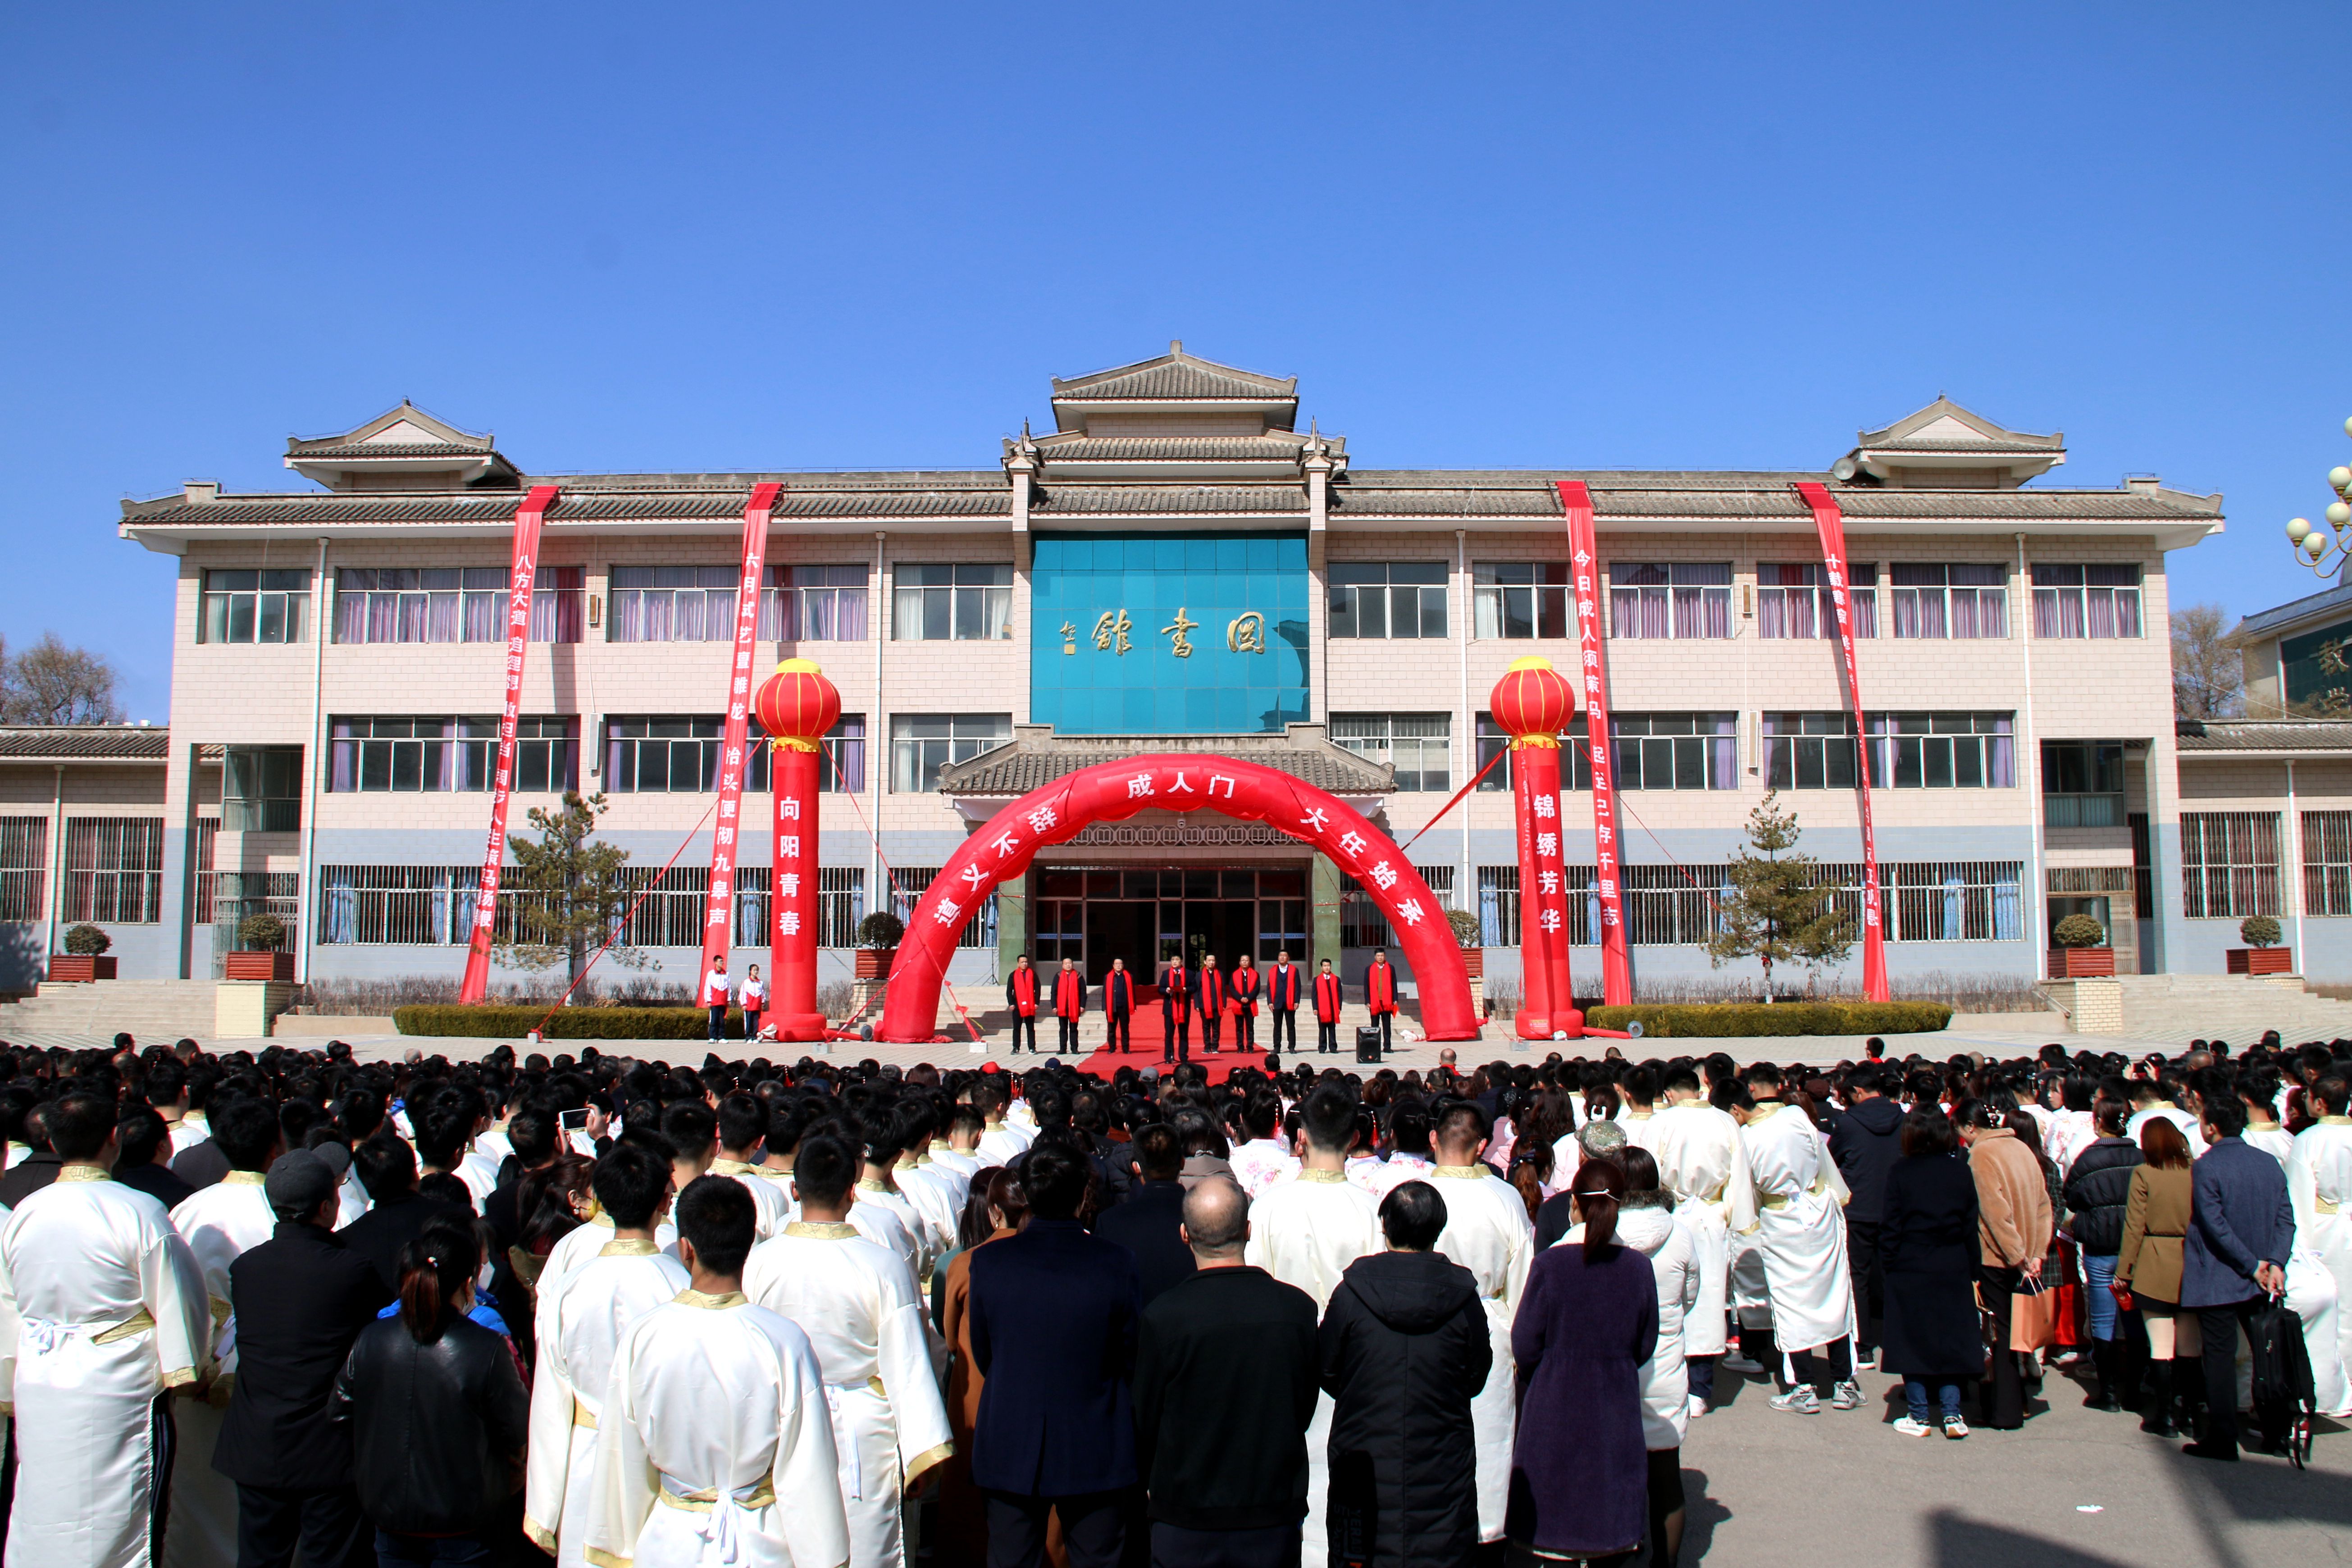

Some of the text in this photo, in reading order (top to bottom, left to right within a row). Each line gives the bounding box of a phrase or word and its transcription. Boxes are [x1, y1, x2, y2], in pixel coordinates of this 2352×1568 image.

[511, 555, 533, 626] 八方大道
[779, 796, 800, 935] 向阳青春
[934, 807, 1057, 928] 道义不辞
[1128, 772, 1235, 799] 成人门
[1300, 807, 1425, 926] 大任始承
[1533, 794, 1561, 933] 锦绣芳华
